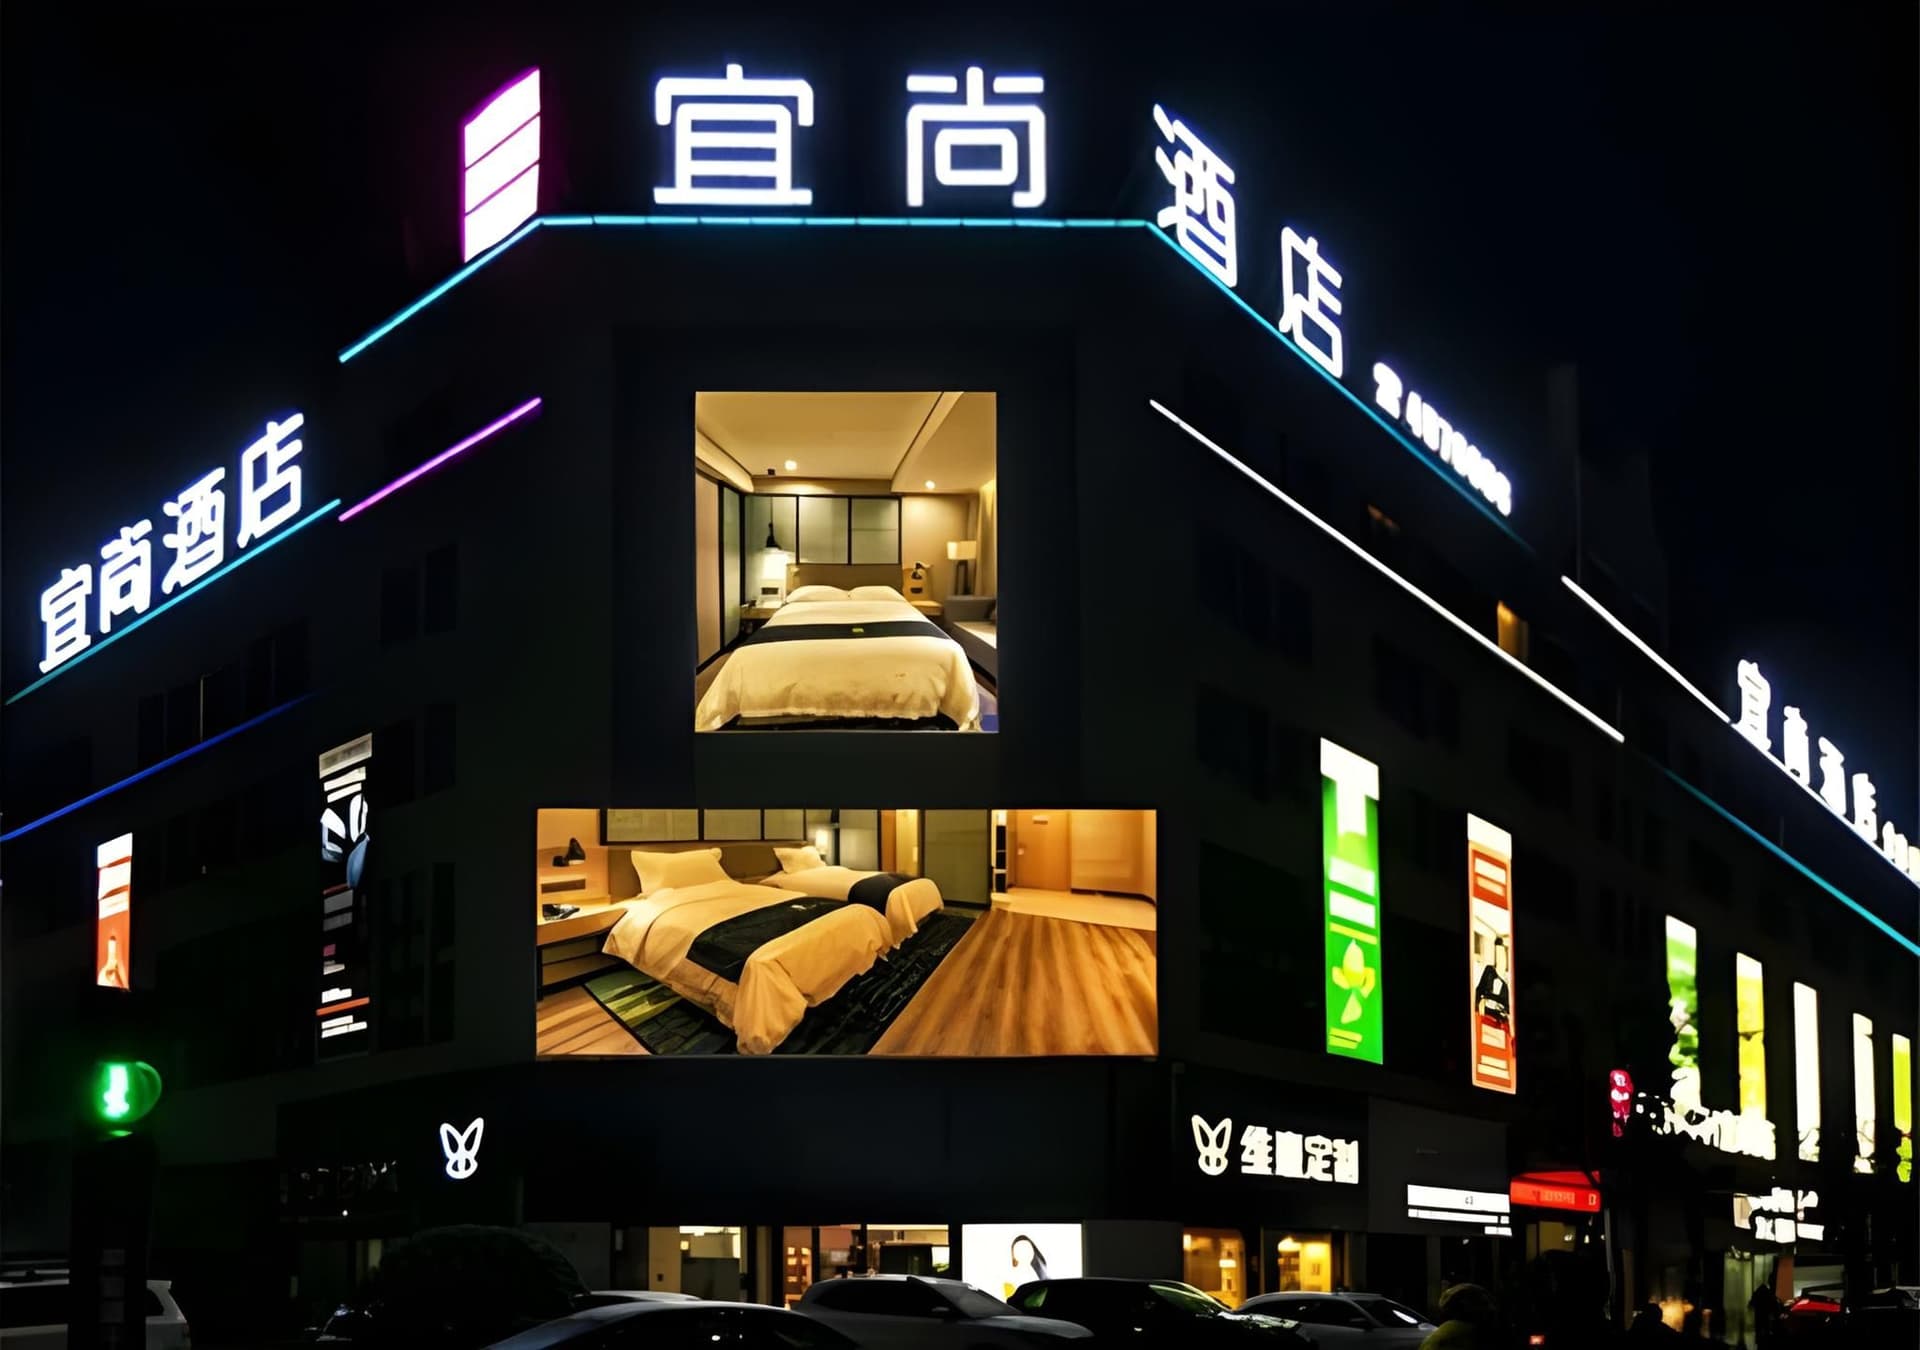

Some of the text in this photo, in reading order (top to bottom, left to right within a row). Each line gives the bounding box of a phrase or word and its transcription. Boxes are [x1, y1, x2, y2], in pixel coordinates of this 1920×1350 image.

[39, 412, 304, 674] 宜尚酒店
[1240, 1125, 1359, 1184] 维定制
